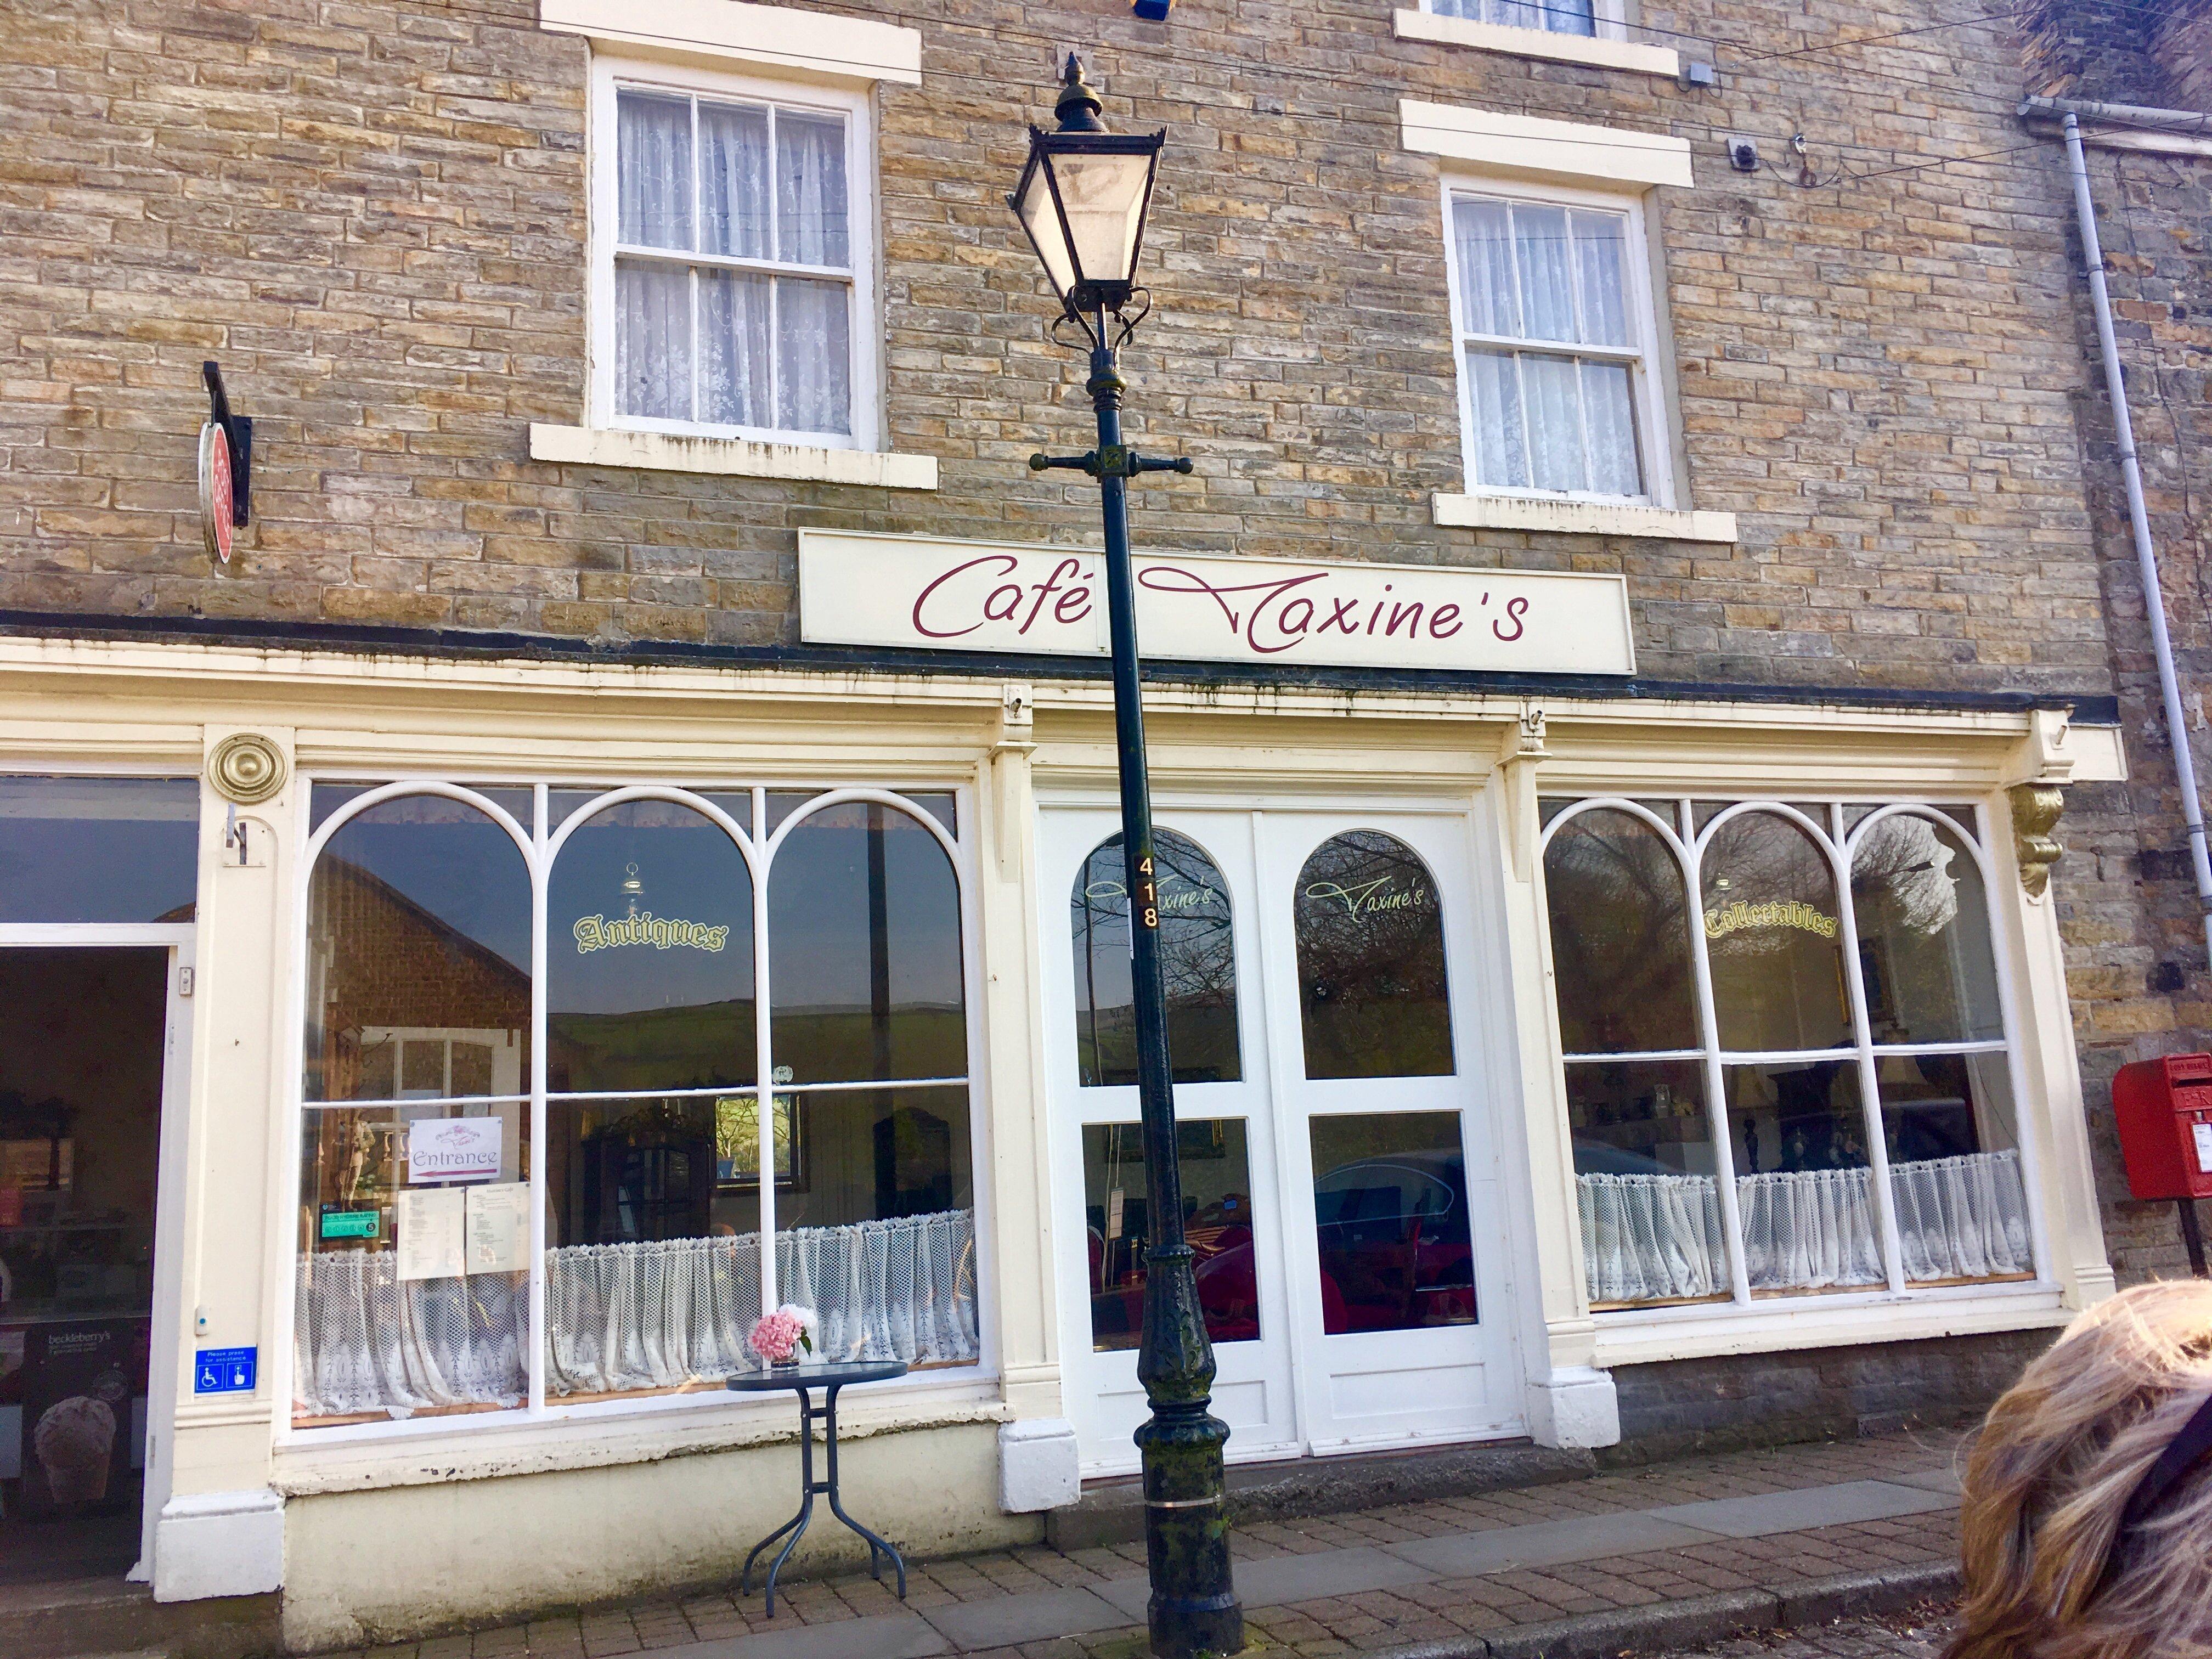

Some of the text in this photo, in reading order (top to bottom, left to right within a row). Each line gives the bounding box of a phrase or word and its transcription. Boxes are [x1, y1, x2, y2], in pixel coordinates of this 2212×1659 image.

[912, 555, 1094, 638] Café
[573, 911, 730, 954] Antiques
[1703, 900, 1838, 938] Collectables
[413, 1151, 498, 1166] Entrance
